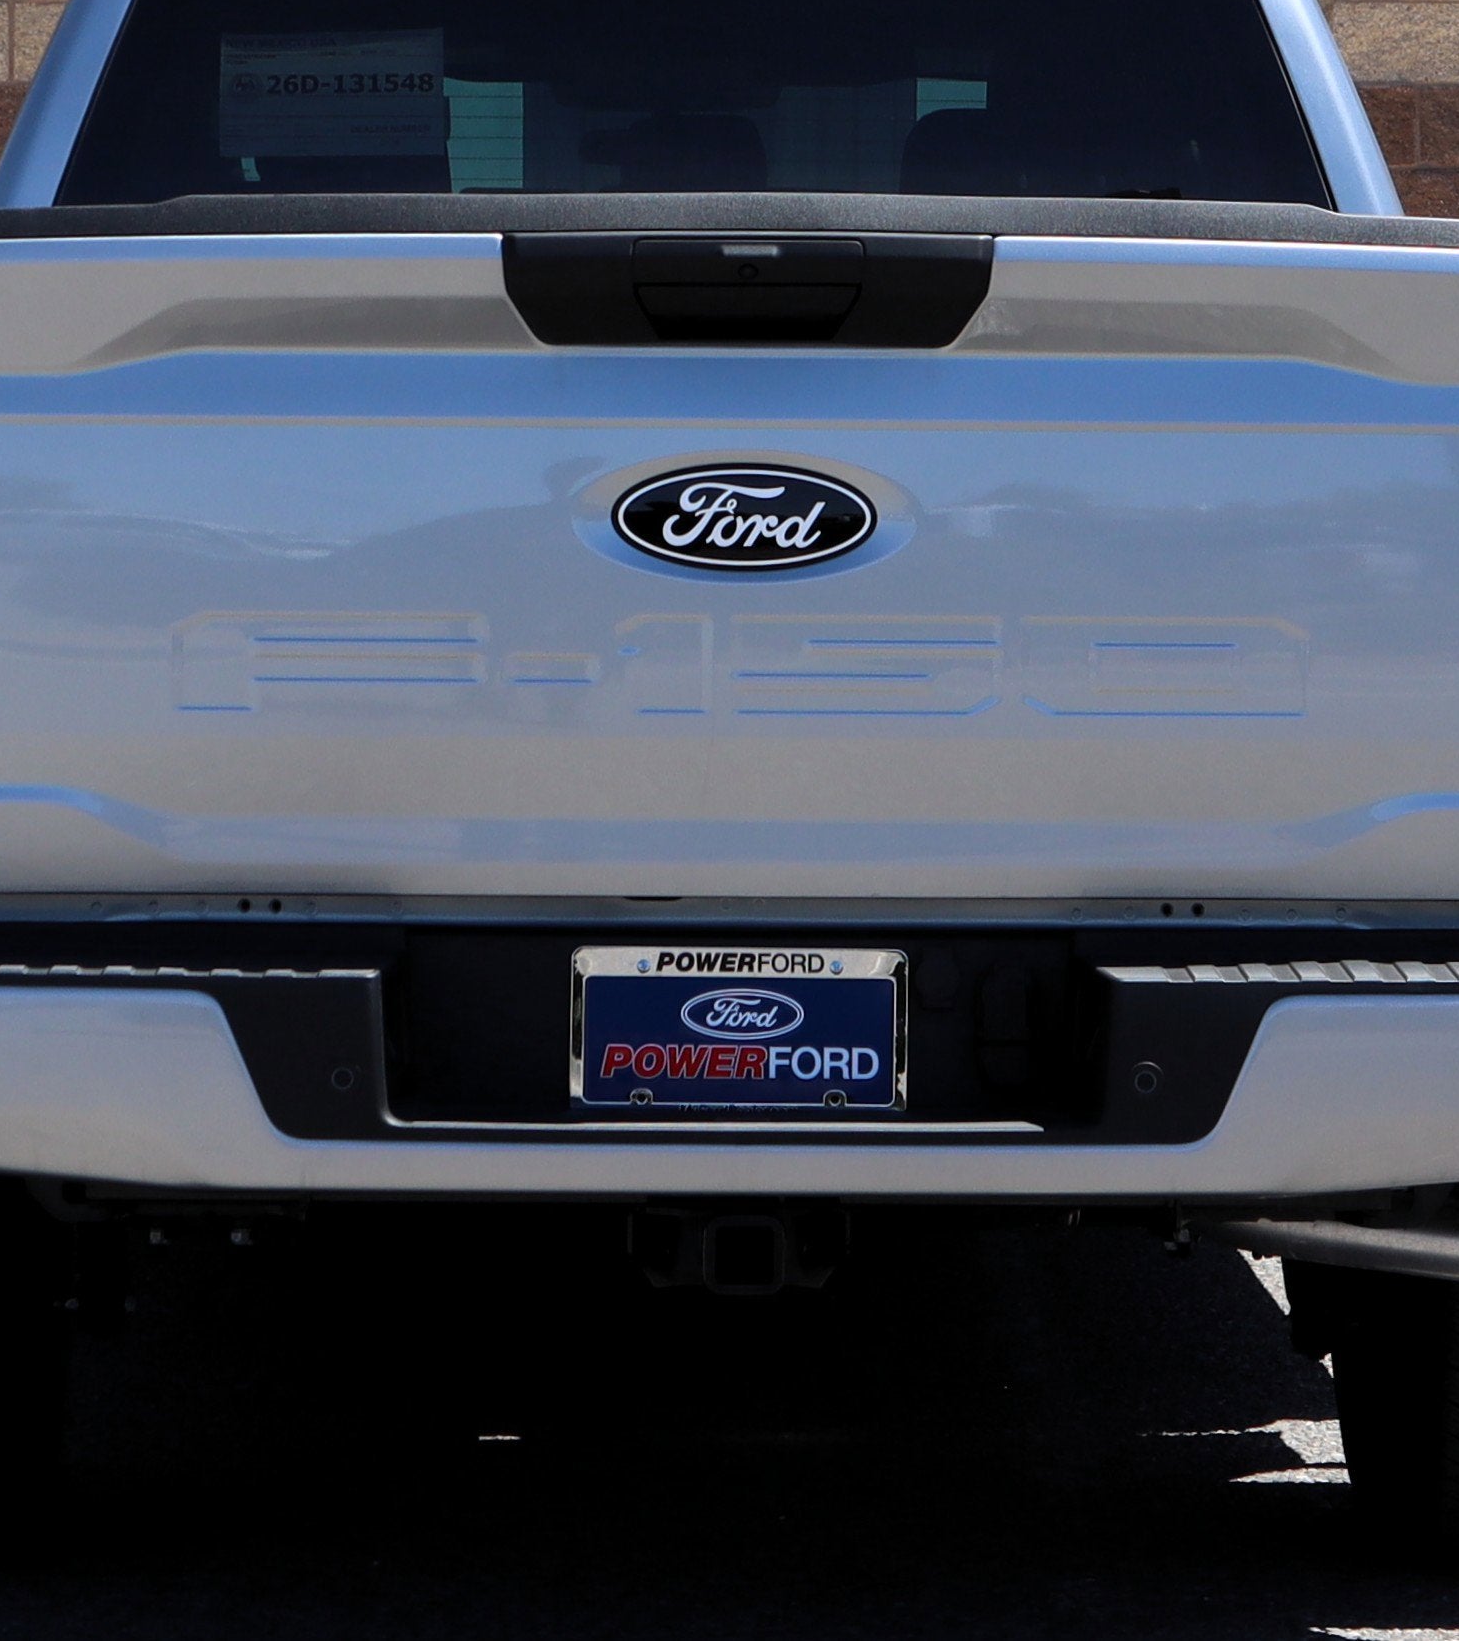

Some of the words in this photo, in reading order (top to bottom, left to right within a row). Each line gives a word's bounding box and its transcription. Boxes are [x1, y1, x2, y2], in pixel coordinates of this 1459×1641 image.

[266, 72, 434, 95] 26D-131548
[662, 482, 826, 548] Ford
[655, 952, 826, 974] POWERFORD
[705, 997, 778, 1029] Ford
[600, 1043, 880, 1080] POWERFORD
